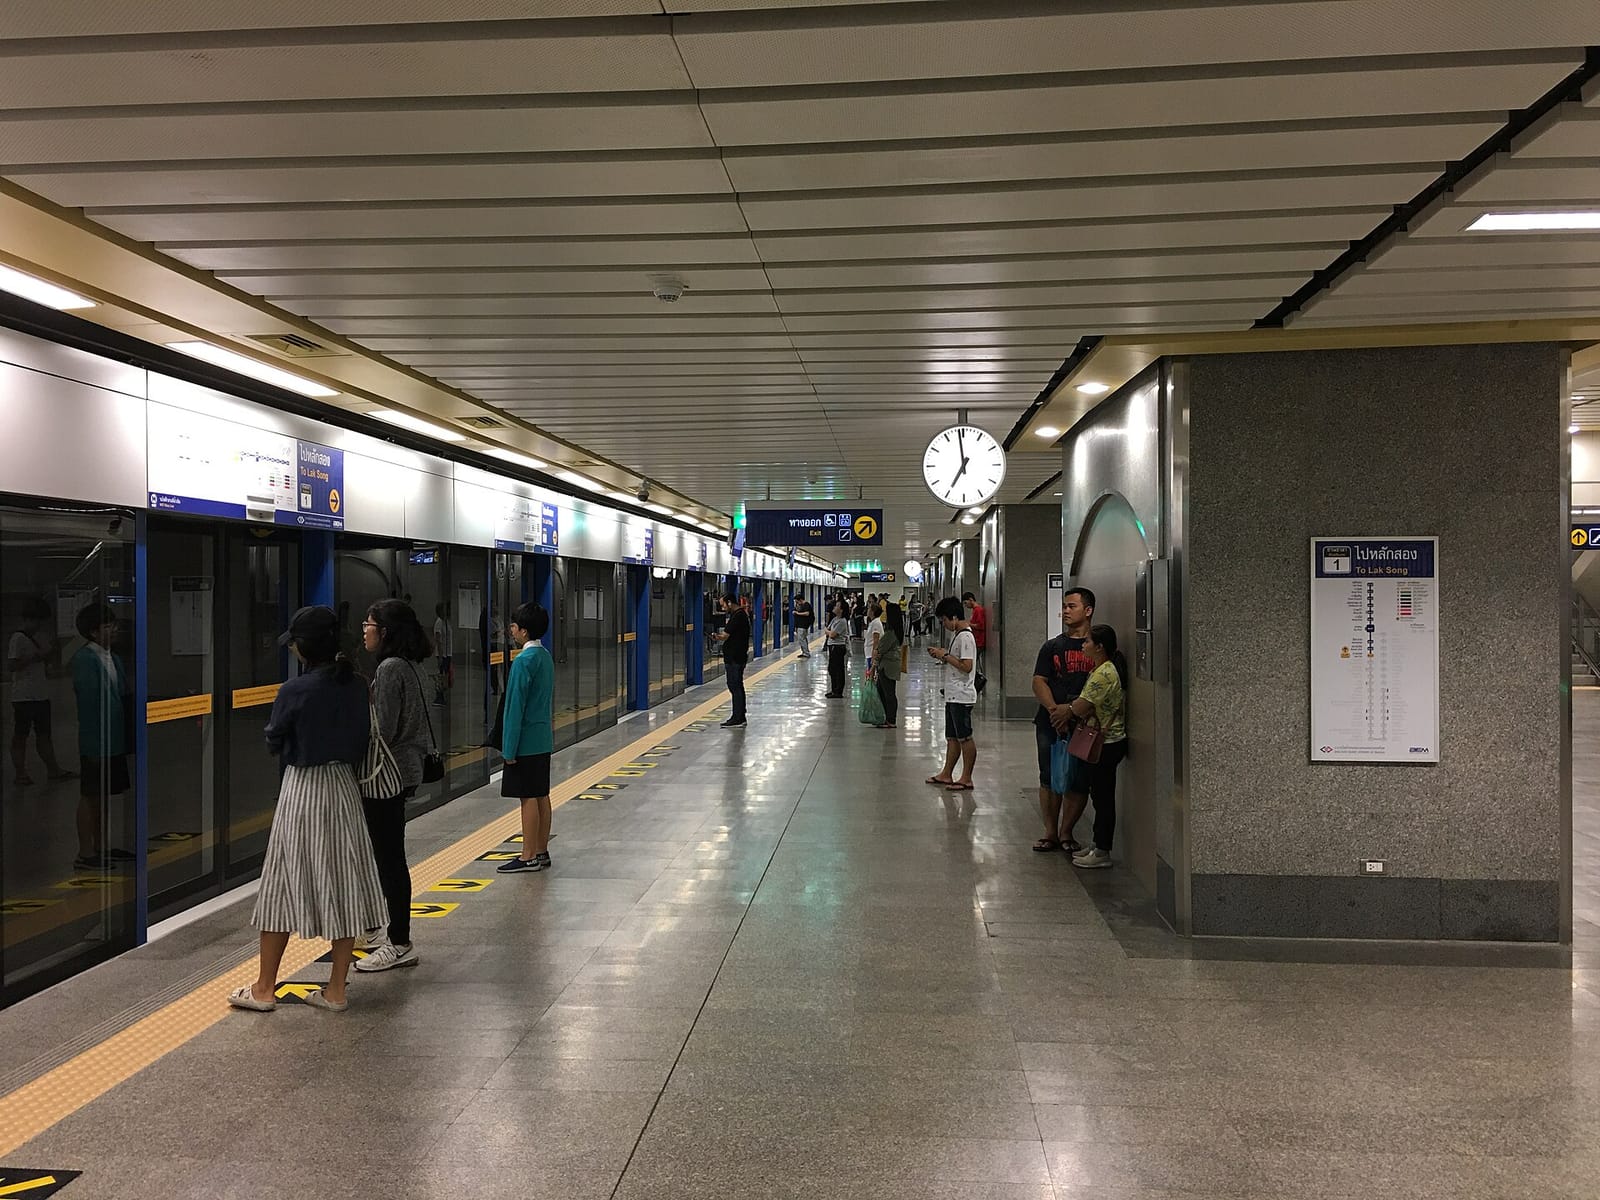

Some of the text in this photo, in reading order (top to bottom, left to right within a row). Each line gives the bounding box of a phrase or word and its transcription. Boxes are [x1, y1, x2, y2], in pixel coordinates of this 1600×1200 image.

[301, 466, 329, 482] To Lak Song
[789, 519, 821, 527] ทางออก
[1354, 545, 1417, 560] ไปหลักสอง
[1333, 559, 1340, 570] 1
[1355, 566, 1408, 576] To Lak Song
